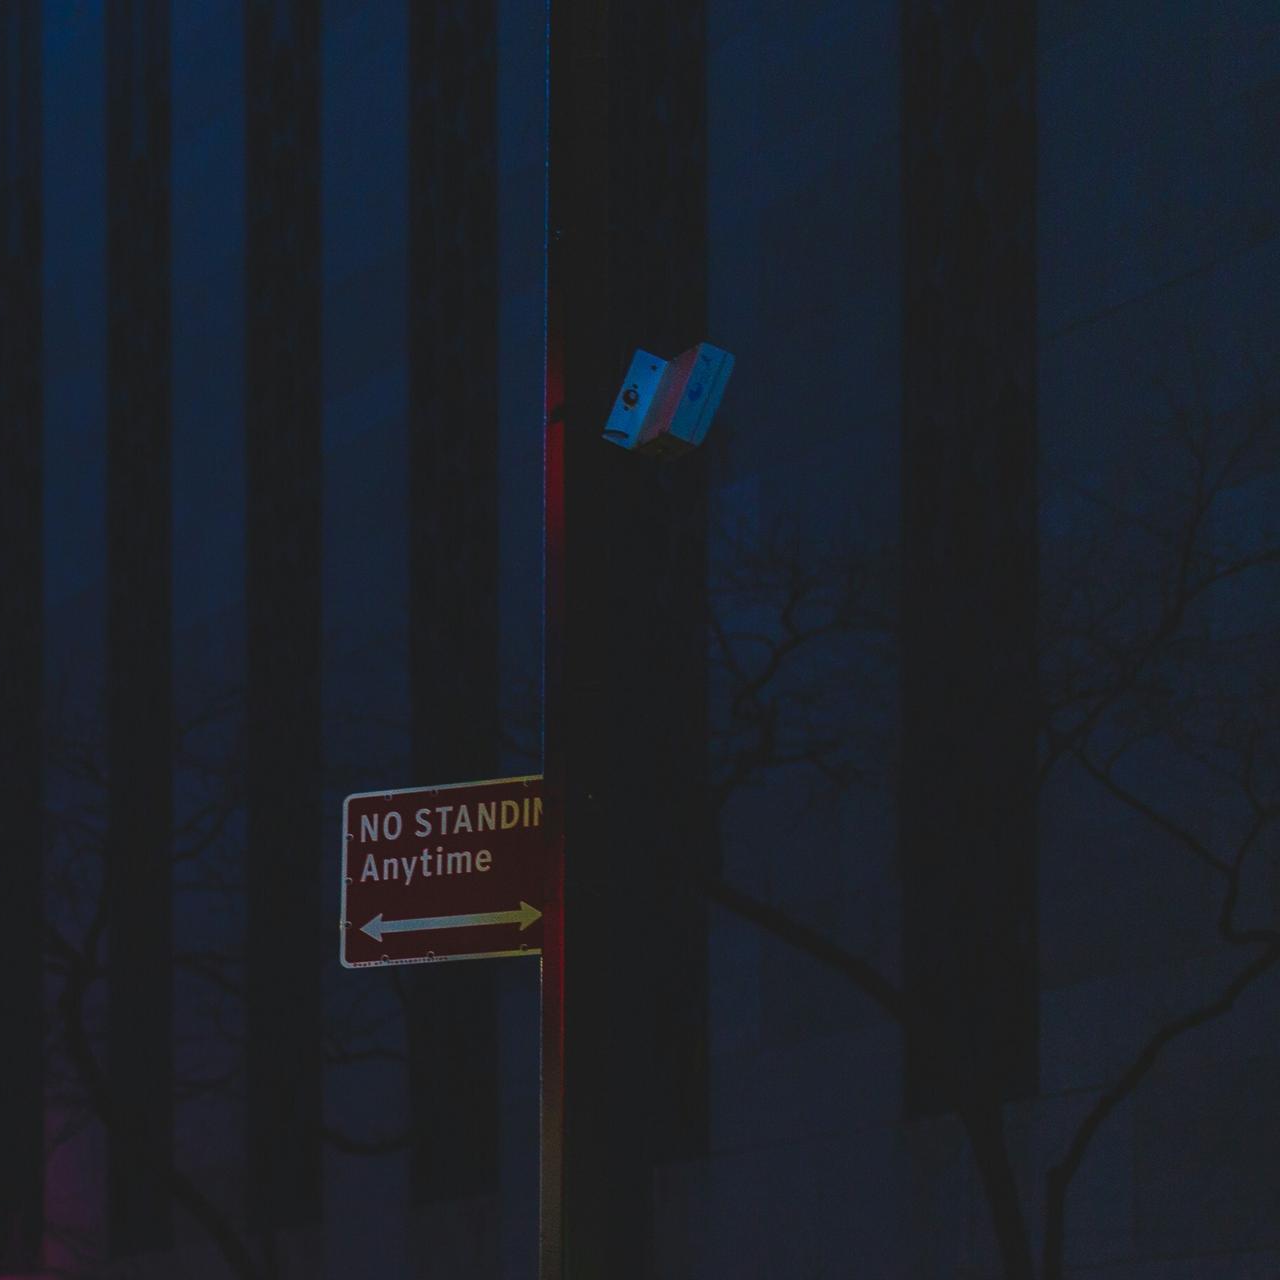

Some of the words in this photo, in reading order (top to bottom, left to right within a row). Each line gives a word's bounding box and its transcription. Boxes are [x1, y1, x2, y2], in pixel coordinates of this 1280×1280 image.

[360, 811, 403, 843] NO
[414, 796, 544, 838] STANDIN
[360, 846, 493, 886] Anytime
